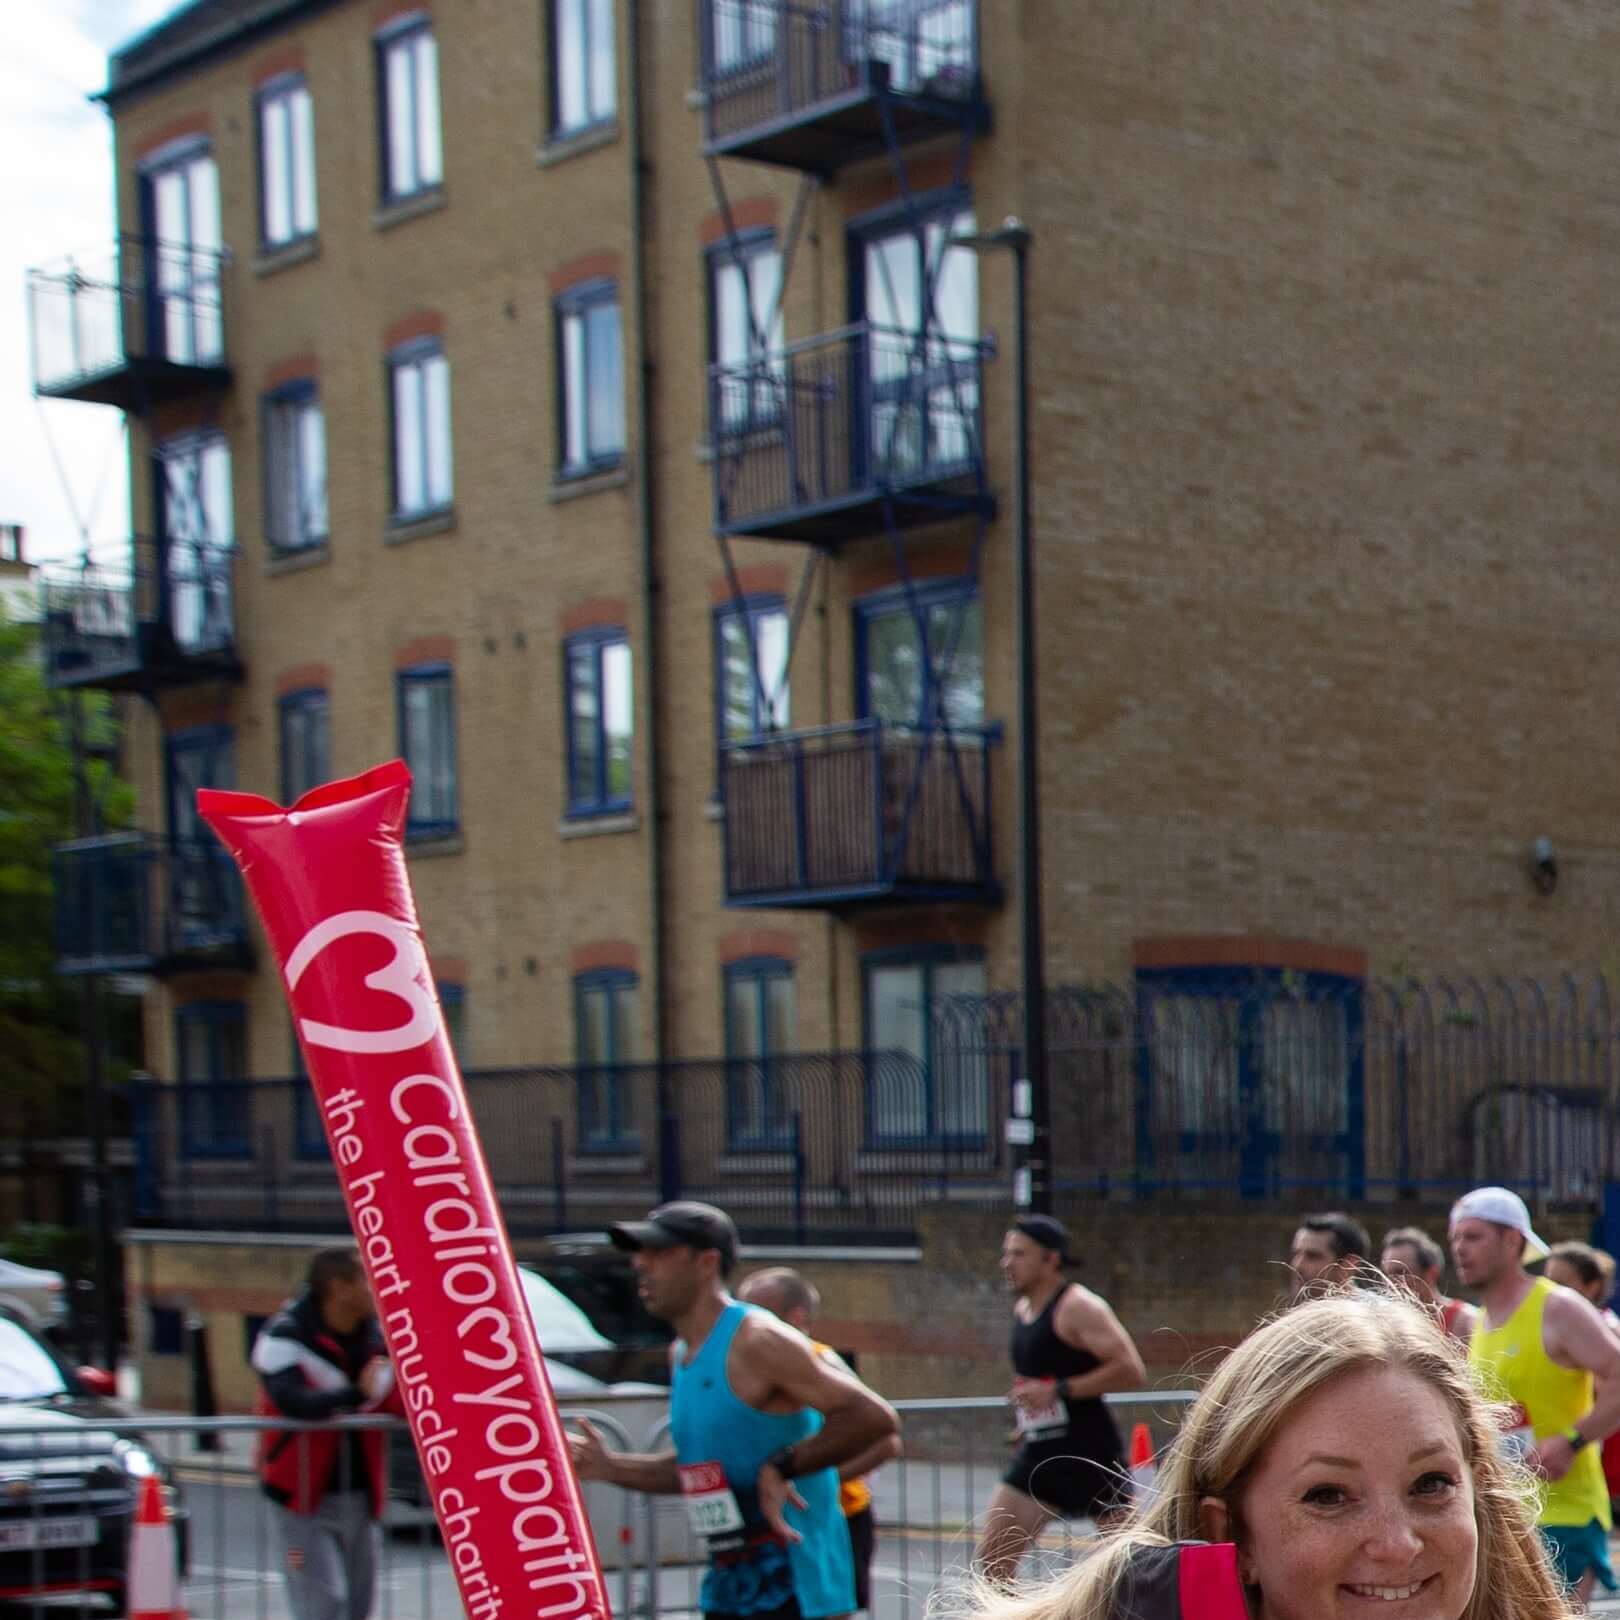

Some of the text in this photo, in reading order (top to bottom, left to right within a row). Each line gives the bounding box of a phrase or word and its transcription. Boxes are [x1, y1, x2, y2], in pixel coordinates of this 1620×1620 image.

[324, 1087, 365, 1166] the
[348, 1170, 411, 1298] heart
[386, 1307, 459, 1477] muscle
